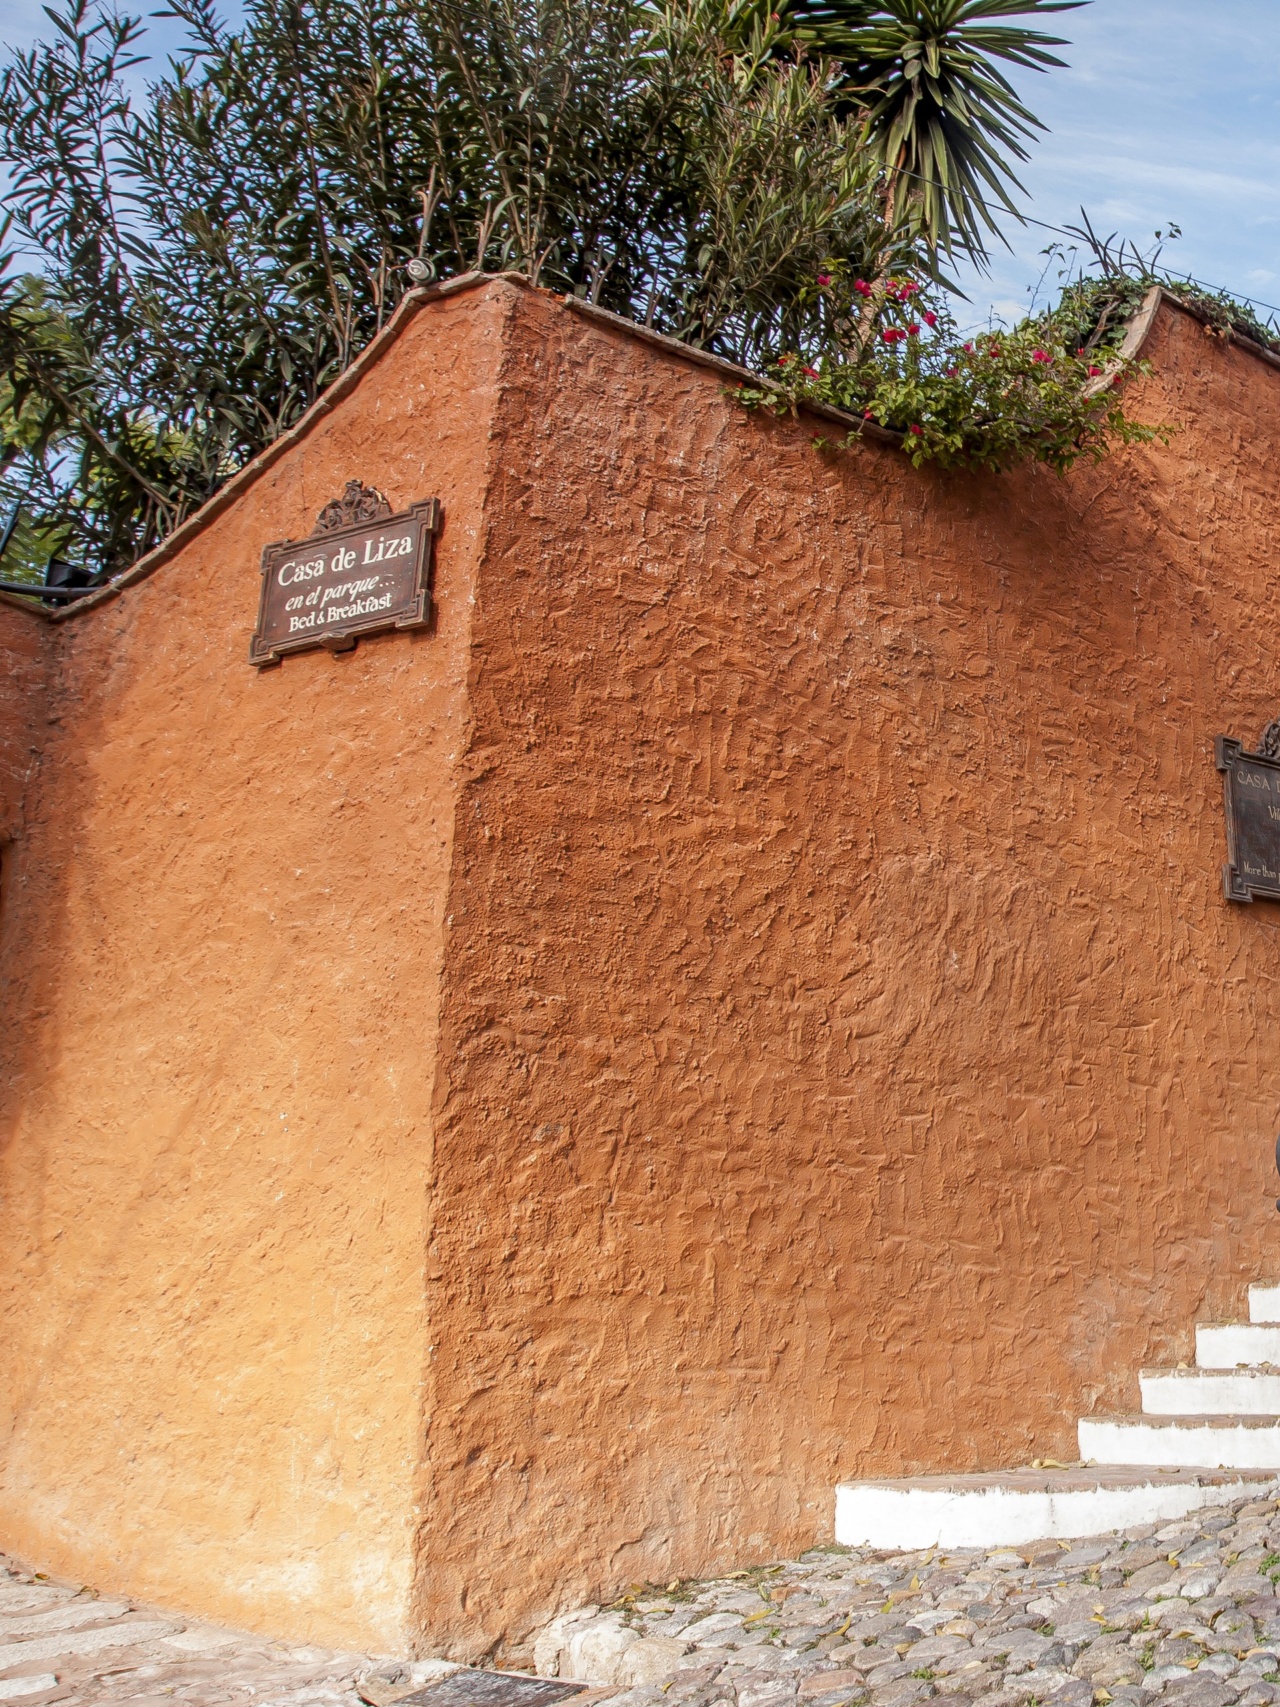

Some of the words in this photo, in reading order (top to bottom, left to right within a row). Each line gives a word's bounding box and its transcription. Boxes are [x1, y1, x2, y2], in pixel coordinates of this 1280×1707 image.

[277, 559, 325, 586] Casa
[331, 547, 356, 572] de
[361, 535, 414, 565] Liza
[285, 595, 304, 611] en
[305, 586, 321, 605] el
[289, 611, 315, 632] Bed
[316, 613, 327, 625] &
[327, 592, 394, 623] Breakfast
[1237, 771, 1270, 791] CASA
[1243, 861, 1261, 876] More
[1262, 865, 1277, 879] than
